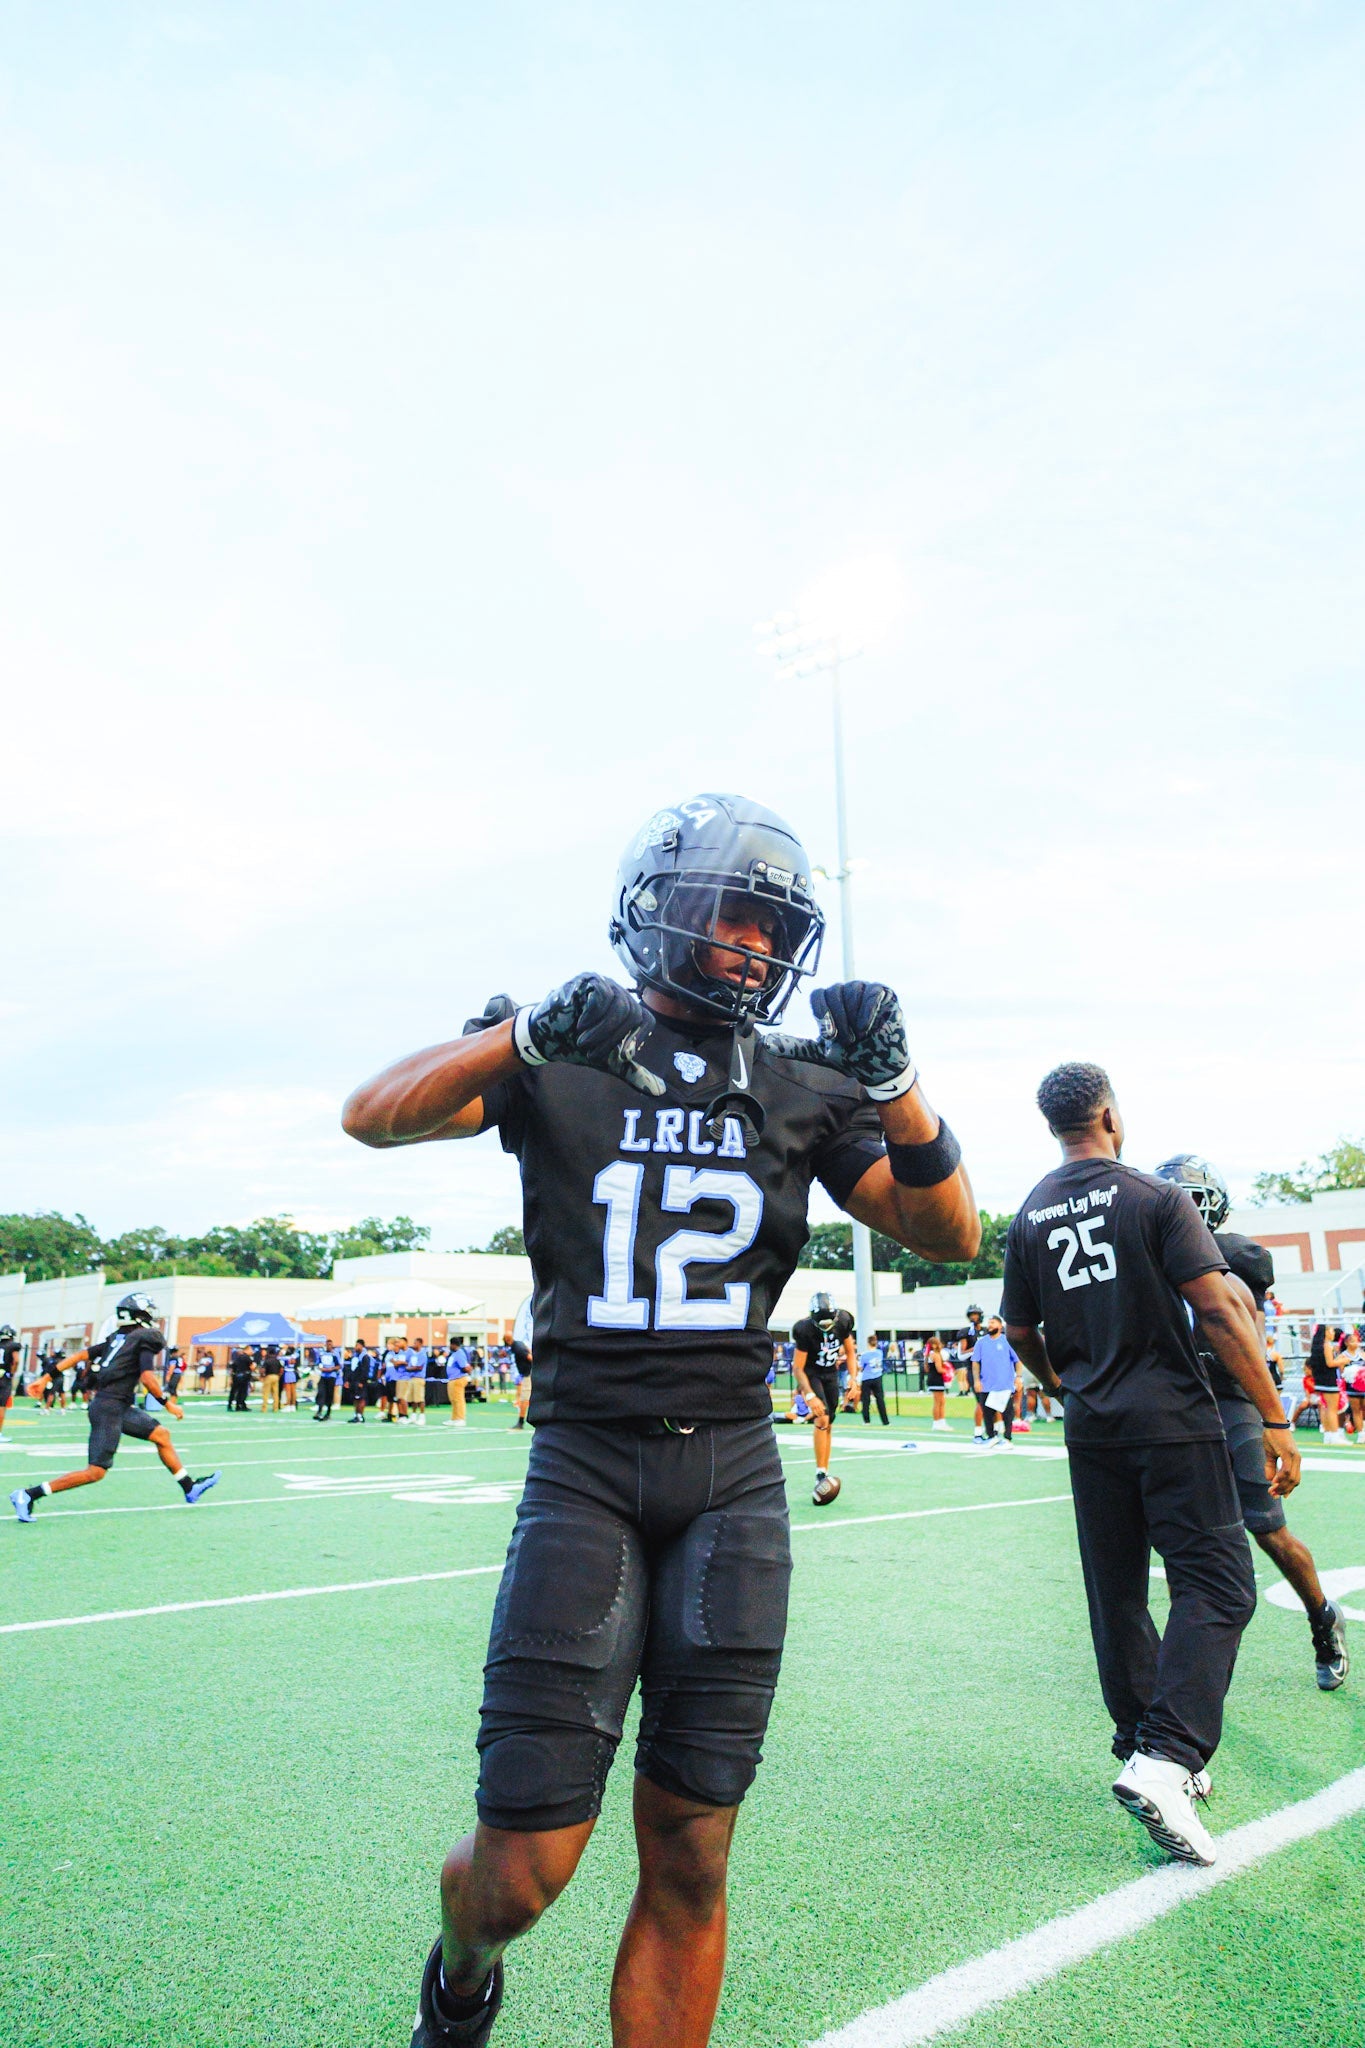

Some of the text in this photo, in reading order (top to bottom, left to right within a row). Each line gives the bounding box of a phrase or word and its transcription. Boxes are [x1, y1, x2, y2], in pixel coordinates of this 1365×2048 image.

[620, 1107, 747, 1158] LRCA
[1068, 1196, 1089, 1215] Lay
[586, 1159, 765, 1331] 12
[1047, 1215, 1117, 1291] 25
